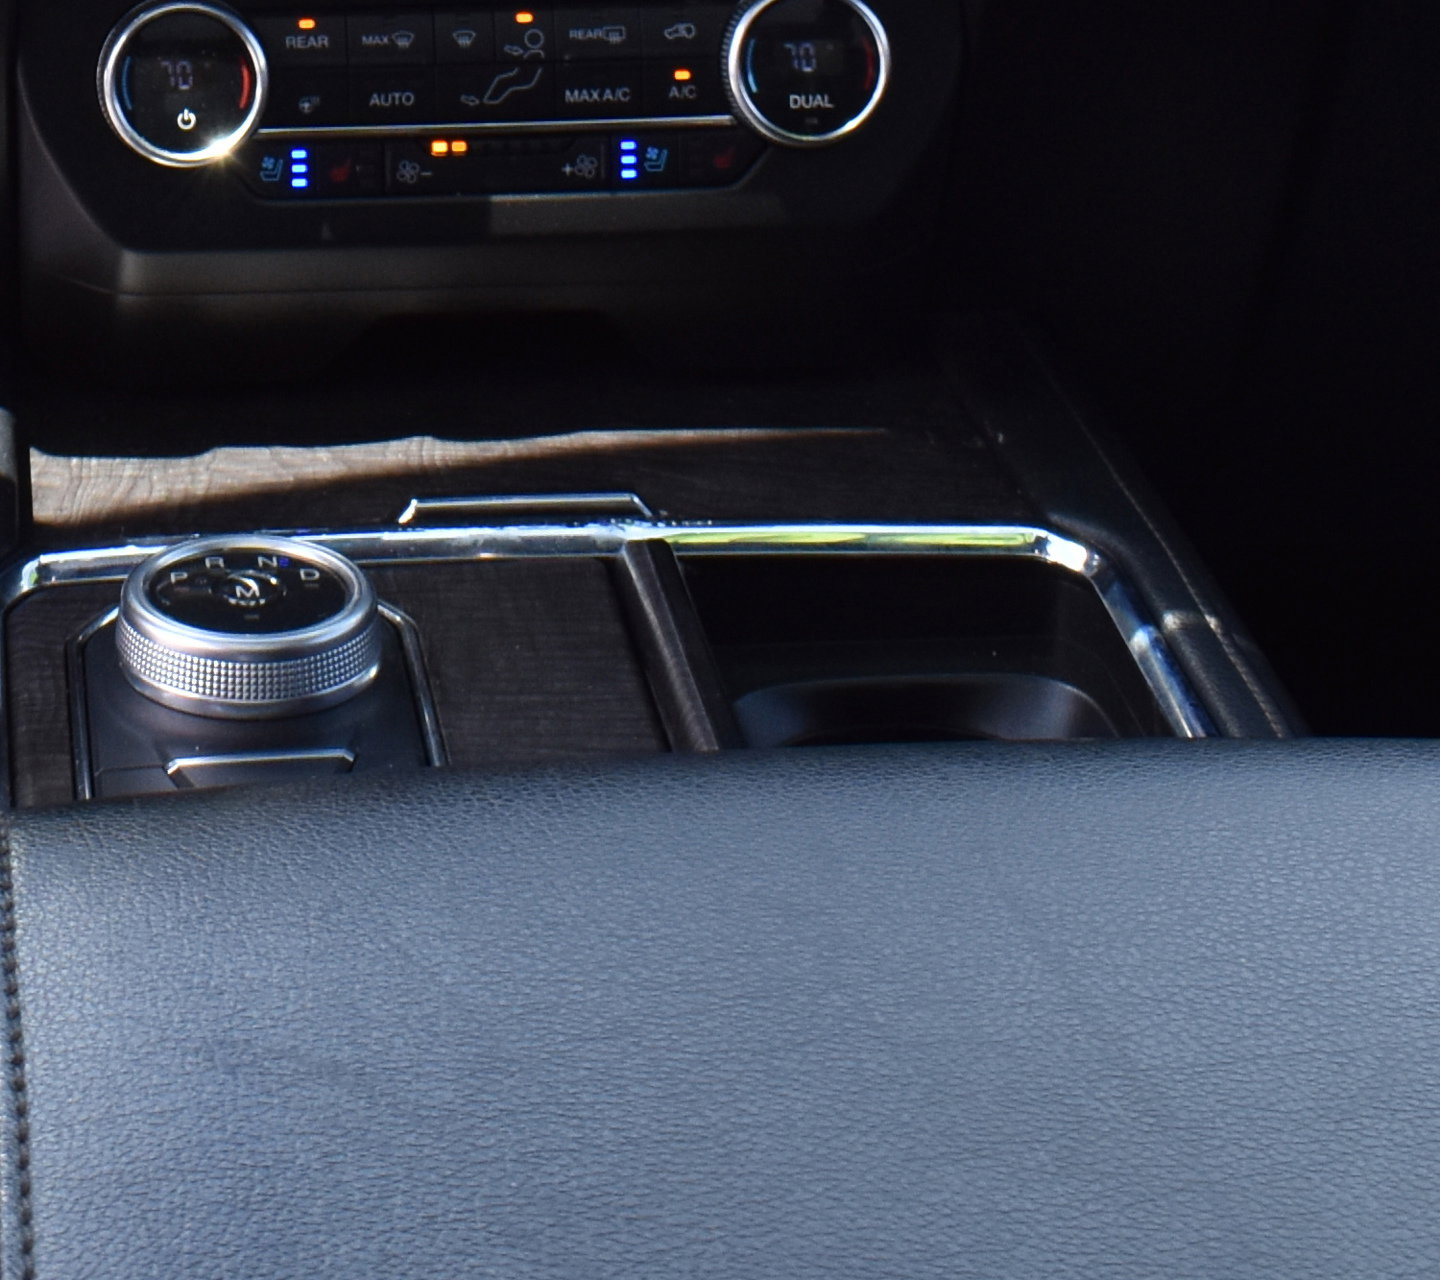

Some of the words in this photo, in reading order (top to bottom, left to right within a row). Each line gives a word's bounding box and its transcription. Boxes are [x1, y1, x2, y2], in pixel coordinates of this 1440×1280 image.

[286, 34, 329, 49] REAR
[361, 34, 389, 47] MAX
[569, 28, 604, 42] REAR
[784, 43, 818, 72] 70
[160, 60, 194, 89] 70
[368, 91, 415, 108] AUTO
[565, 87, 599, 104] MAX
[600, 87, 632, 104] A/C
[668, 84, 697, 101] A/C
[789, 93, 835, 111] DUAL
[205, 556, 224, 569] R
[257, 555, 278, 568] N
[170, 571, 189, 584] P
[299, 568, 321, 581] D
[235, 581, 261, 598] M
